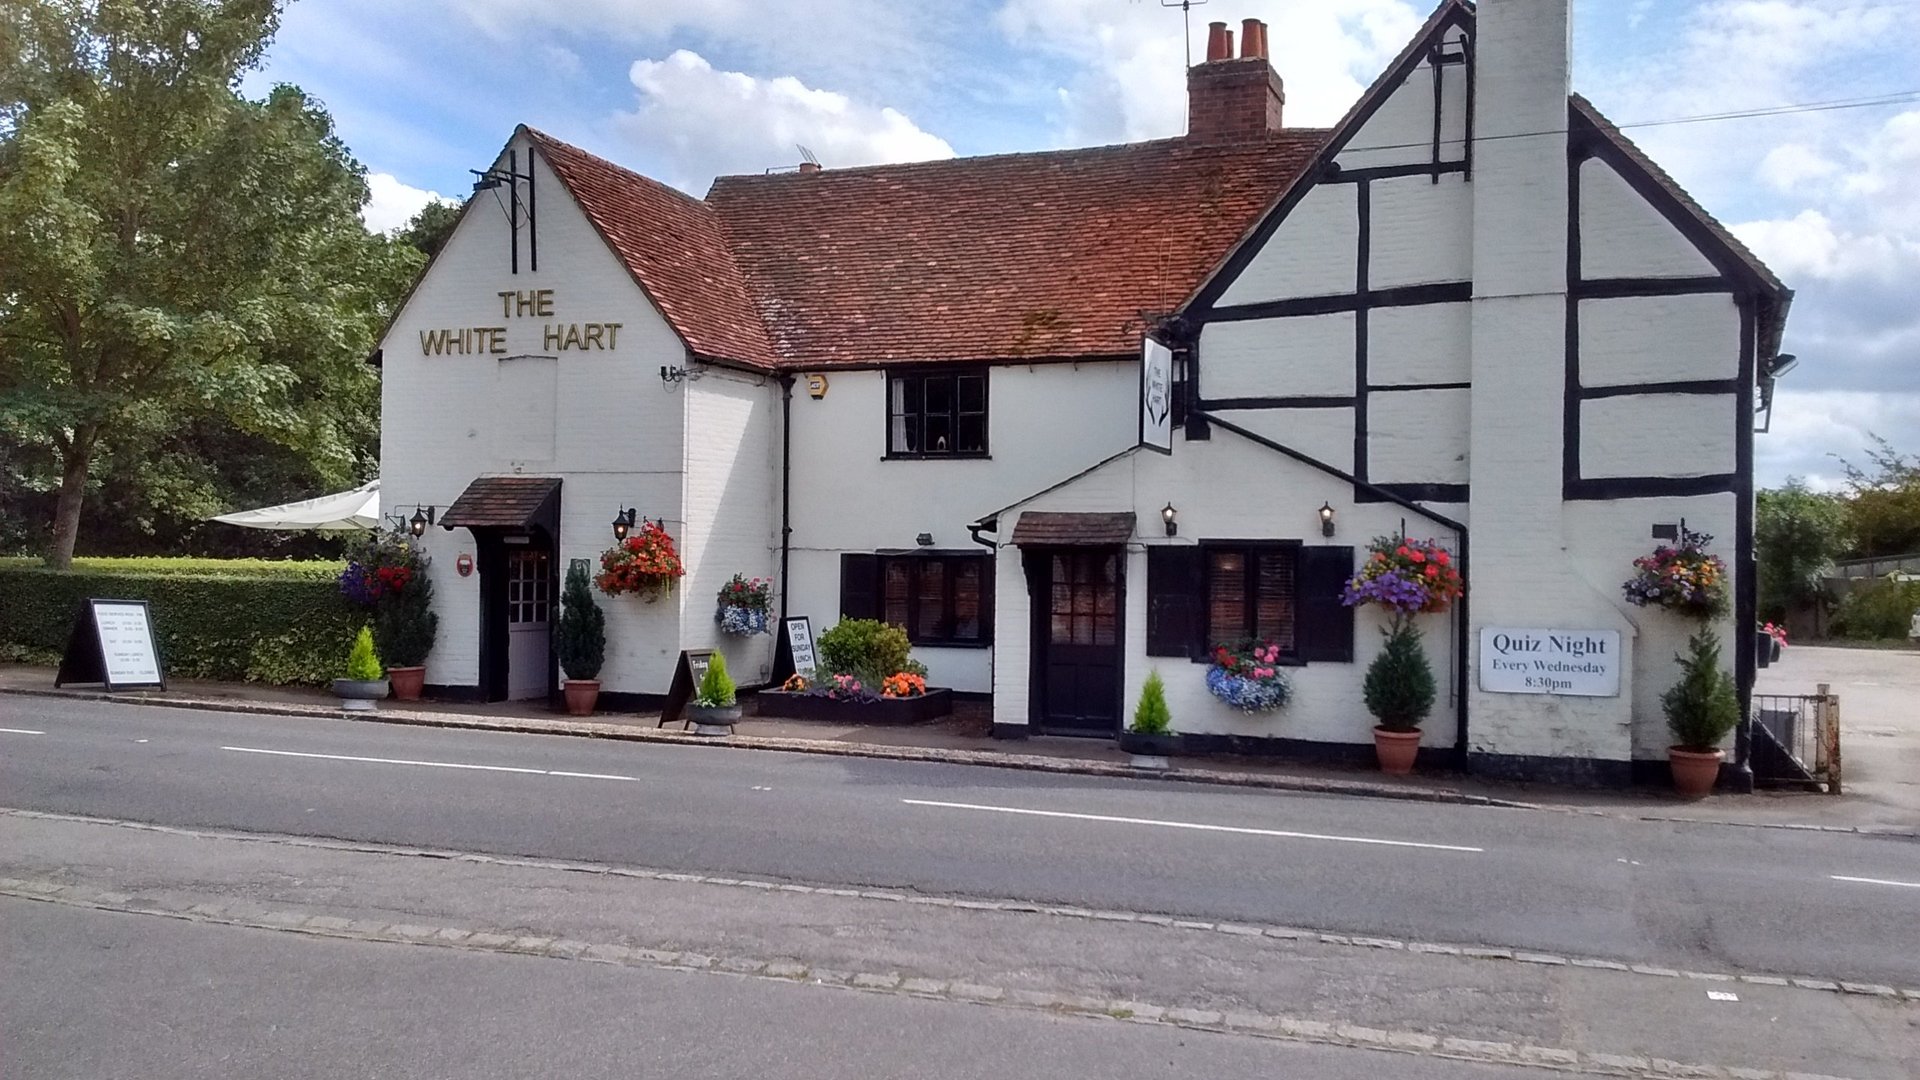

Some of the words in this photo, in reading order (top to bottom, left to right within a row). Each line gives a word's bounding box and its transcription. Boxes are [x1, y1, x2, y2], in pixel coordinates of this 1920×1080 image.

[498, 289, 554, 318] THE
[419, 327, 507, 356] WHITE
[543, 322, 623, 351] HART
[790, 622, 804, 631] OPEN
[794, 633, 804, 641] FOR
[792, 644, 810, 652] SUNDAY
[1493, 633, 1542, 655] Quiz
[1549, 635, 1606, 657] Night
[795, 655, 811, 663] LUNCH
[1492, 659, 1529, 673] Every
[1534, 660, 1606, 676] Wednesday
[1525, 676, 1572, 690] 8:30pm
